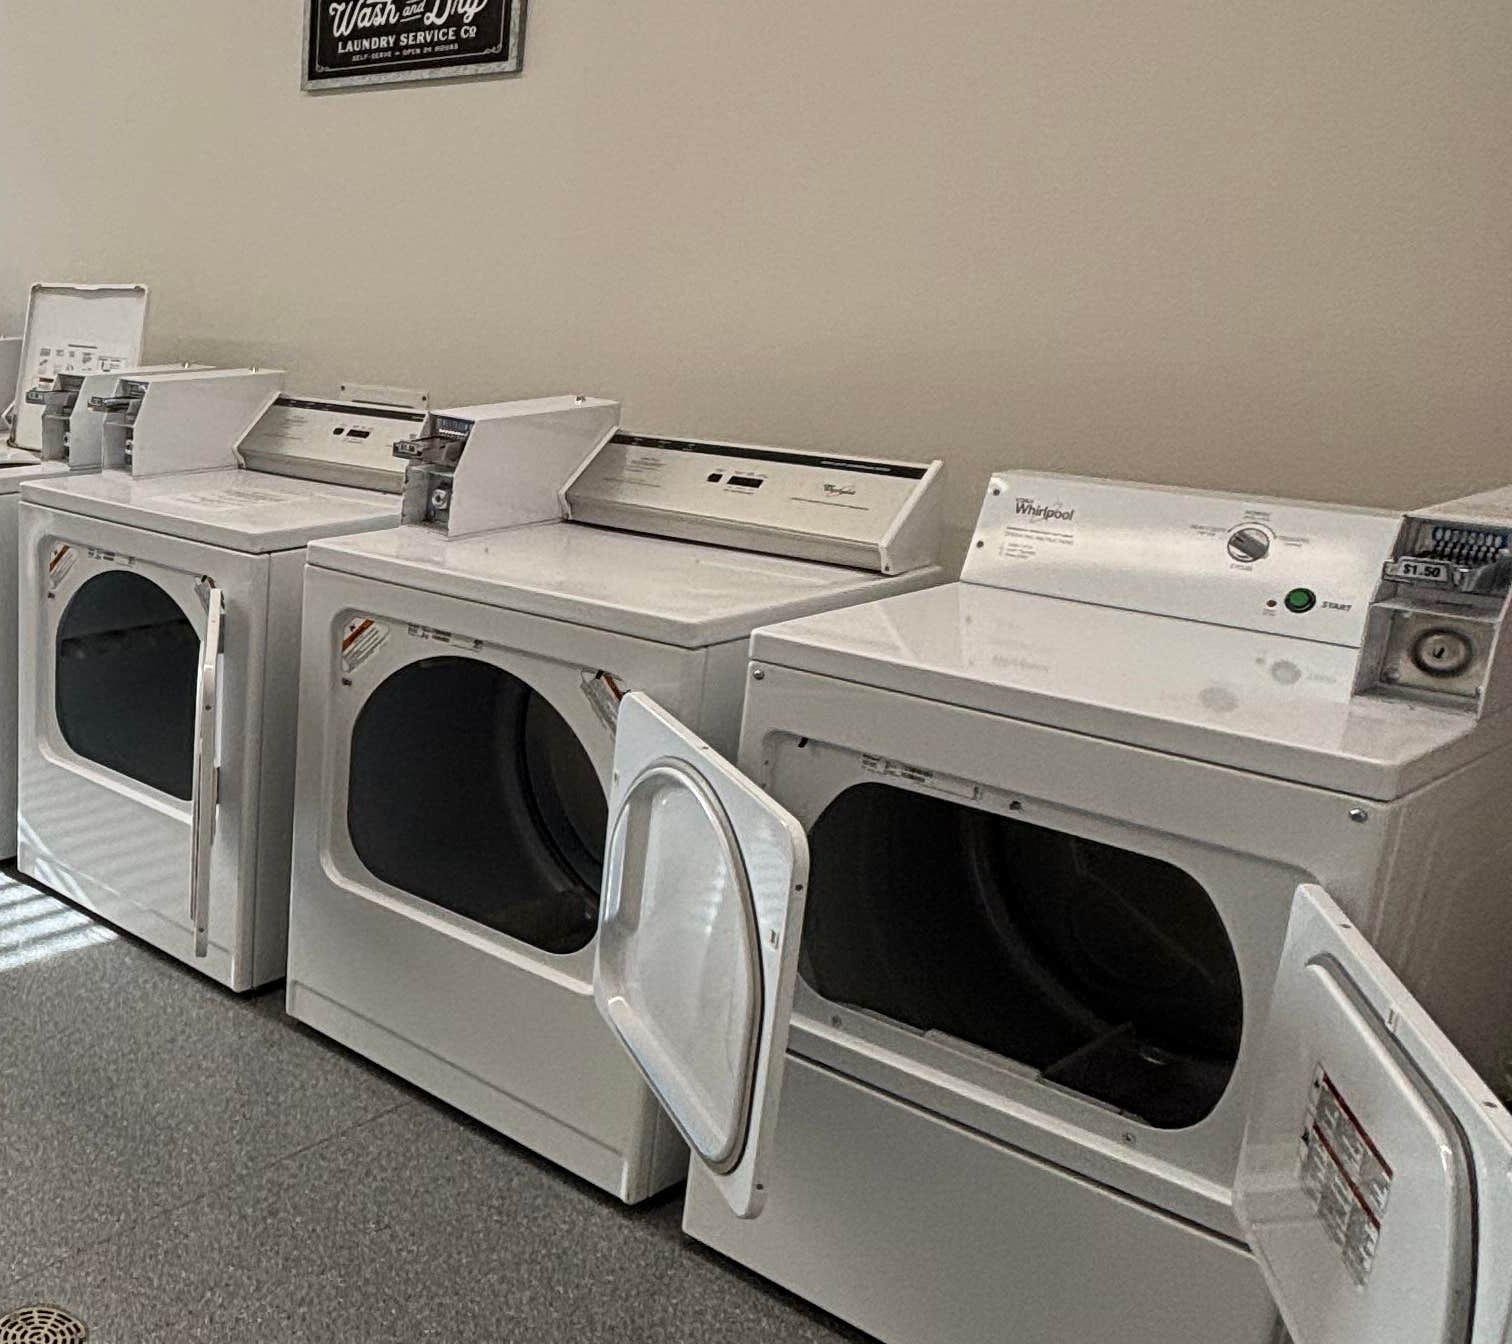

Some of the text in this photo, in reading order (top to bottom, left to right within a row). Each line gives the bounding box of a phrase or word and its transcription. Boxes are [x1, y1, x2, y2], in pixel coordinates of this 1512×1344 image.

[338, 34, 396, 54] LAUNDRY
[400, 27, 457, 46] SERVICE
[1015, 502, 1075, 521] Whirlpool
[1403, 563, 1441, 578] $1.50
[1320, 601, 1352, 612] START
